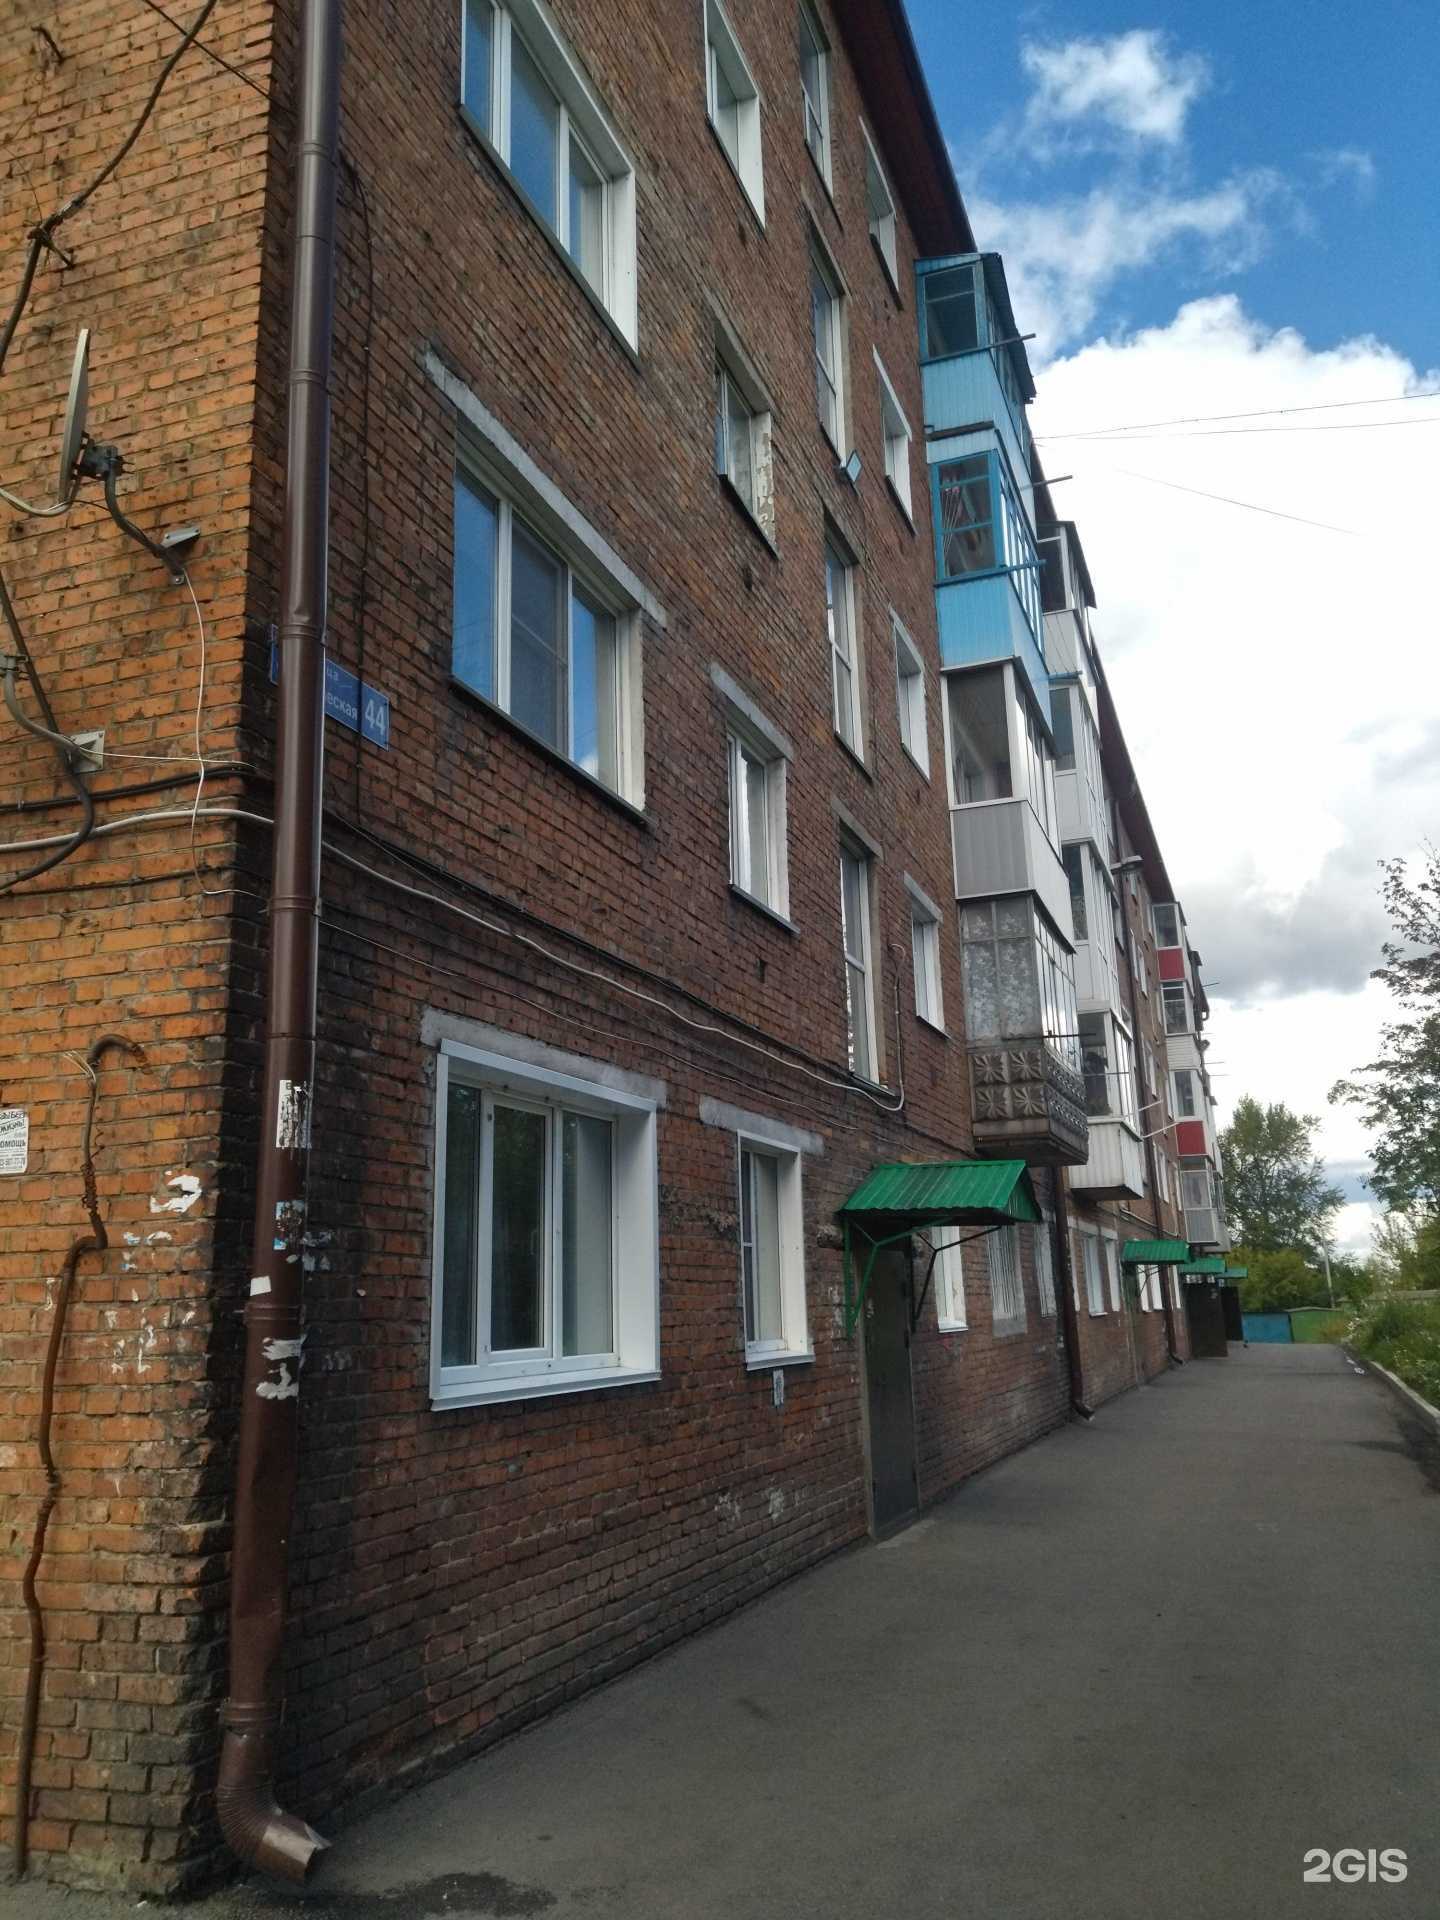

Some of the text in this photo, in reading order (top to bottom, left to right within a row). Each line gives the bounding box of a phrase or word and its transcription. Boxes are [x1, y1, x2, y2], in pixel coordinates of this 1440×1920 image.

[327, 692, 386, 736] еская 44
[0, 1139, 26, 1149] ОМОЩЬ
